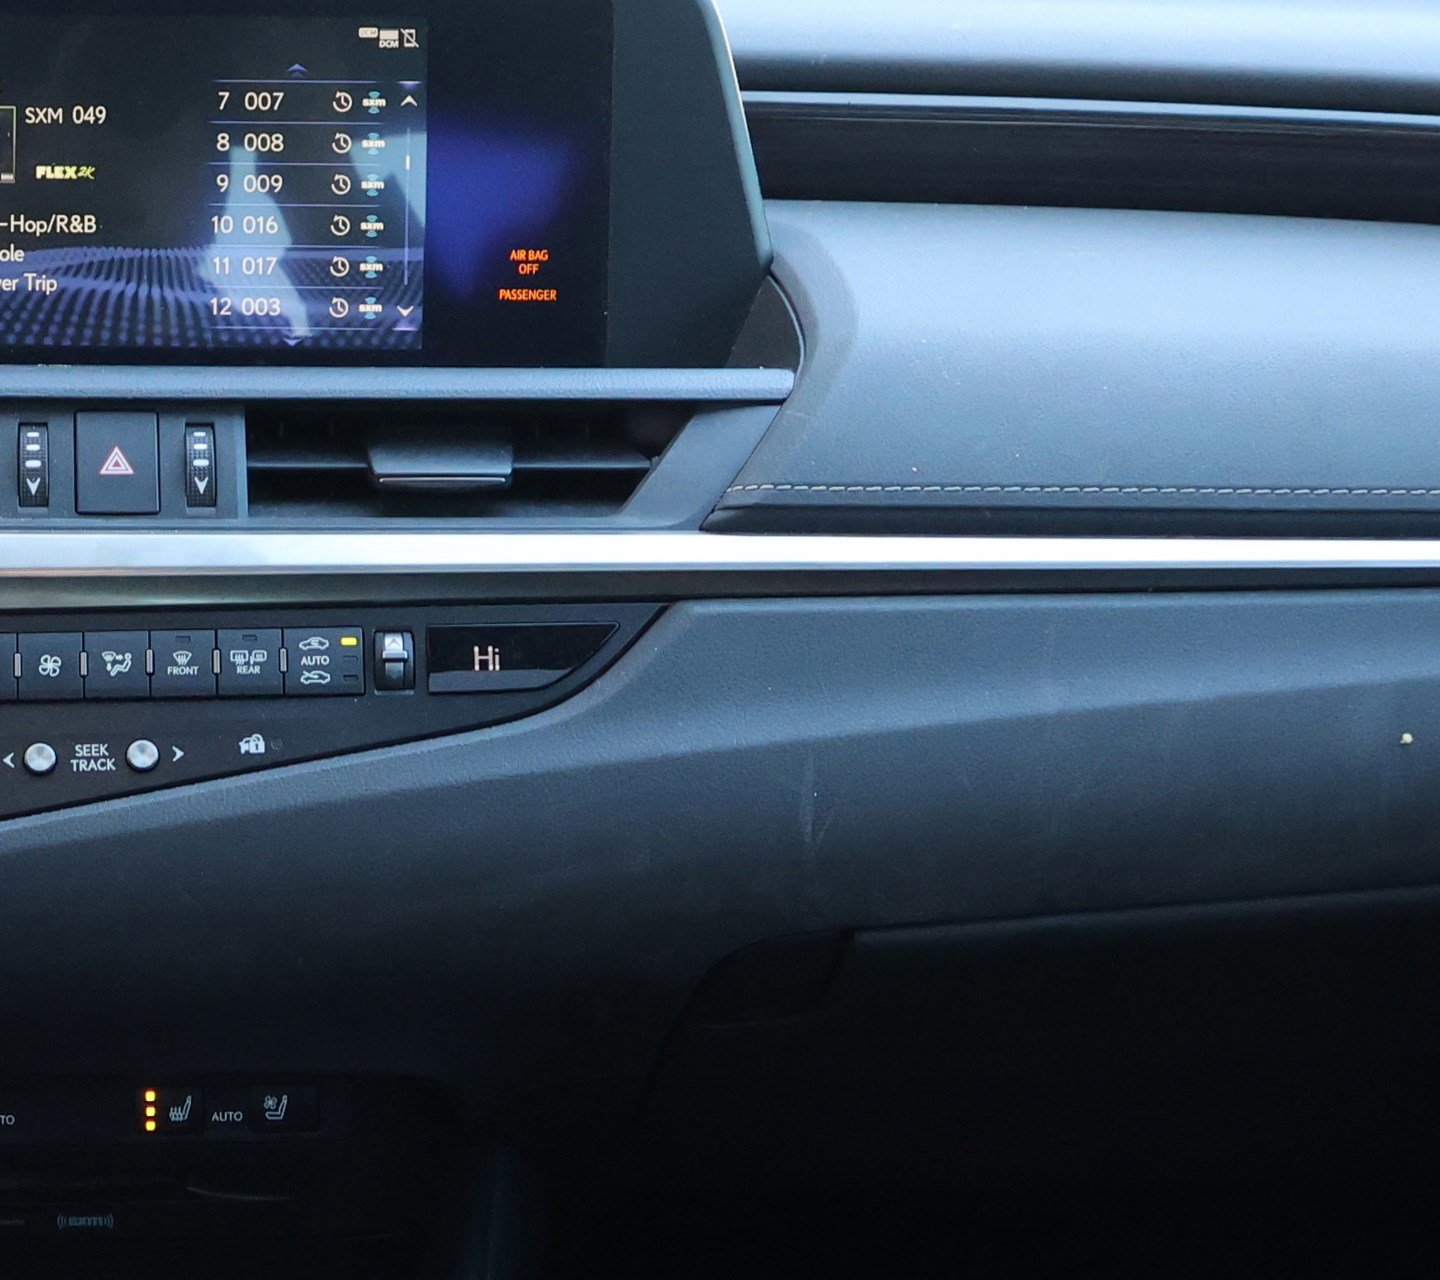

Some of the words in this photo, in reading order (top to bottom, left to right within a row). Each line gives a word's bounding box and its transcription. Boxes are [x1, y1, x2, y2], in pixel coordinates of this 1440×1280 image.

[218, 91, 230, 111] 7
[244, 91, 284, 111] 007
[25, 107, 63, 124] SXM
[72, 105, 107, 124] 049
[216, 133, 230, 152] 8
[244, 133, 284, 152] 008
[216, 174, 229, 193] 9
[243, 174, 283, 193] 009
[211, 215, 234, 234] 10
[242, 215, 279, 234] 016
[510, 249, 526, 261] AIR
[528, 249, 549, 261] BAG
[213, 256, 230, 275] 11
[242, 256, 278, 275] 017
[518, 263, 539, 275] OFF
[23, 273, 58, 295] Trip
[499, 288, 557, 301] PASSENGER
[210, 297, 232, 316] 12
[241, 297, 281, 316] 003
[300, 655, 330, 666] AUTO
[473, 645, 500, 671] Hi
[167, 665, 199, 676] FRONT
[236, 665, 260, 675] REAR
[75, 743, 109, 757] SEEK
[71, 758, 116, 772] TRACK
[211, 1111, 243, 1122] AUTO
